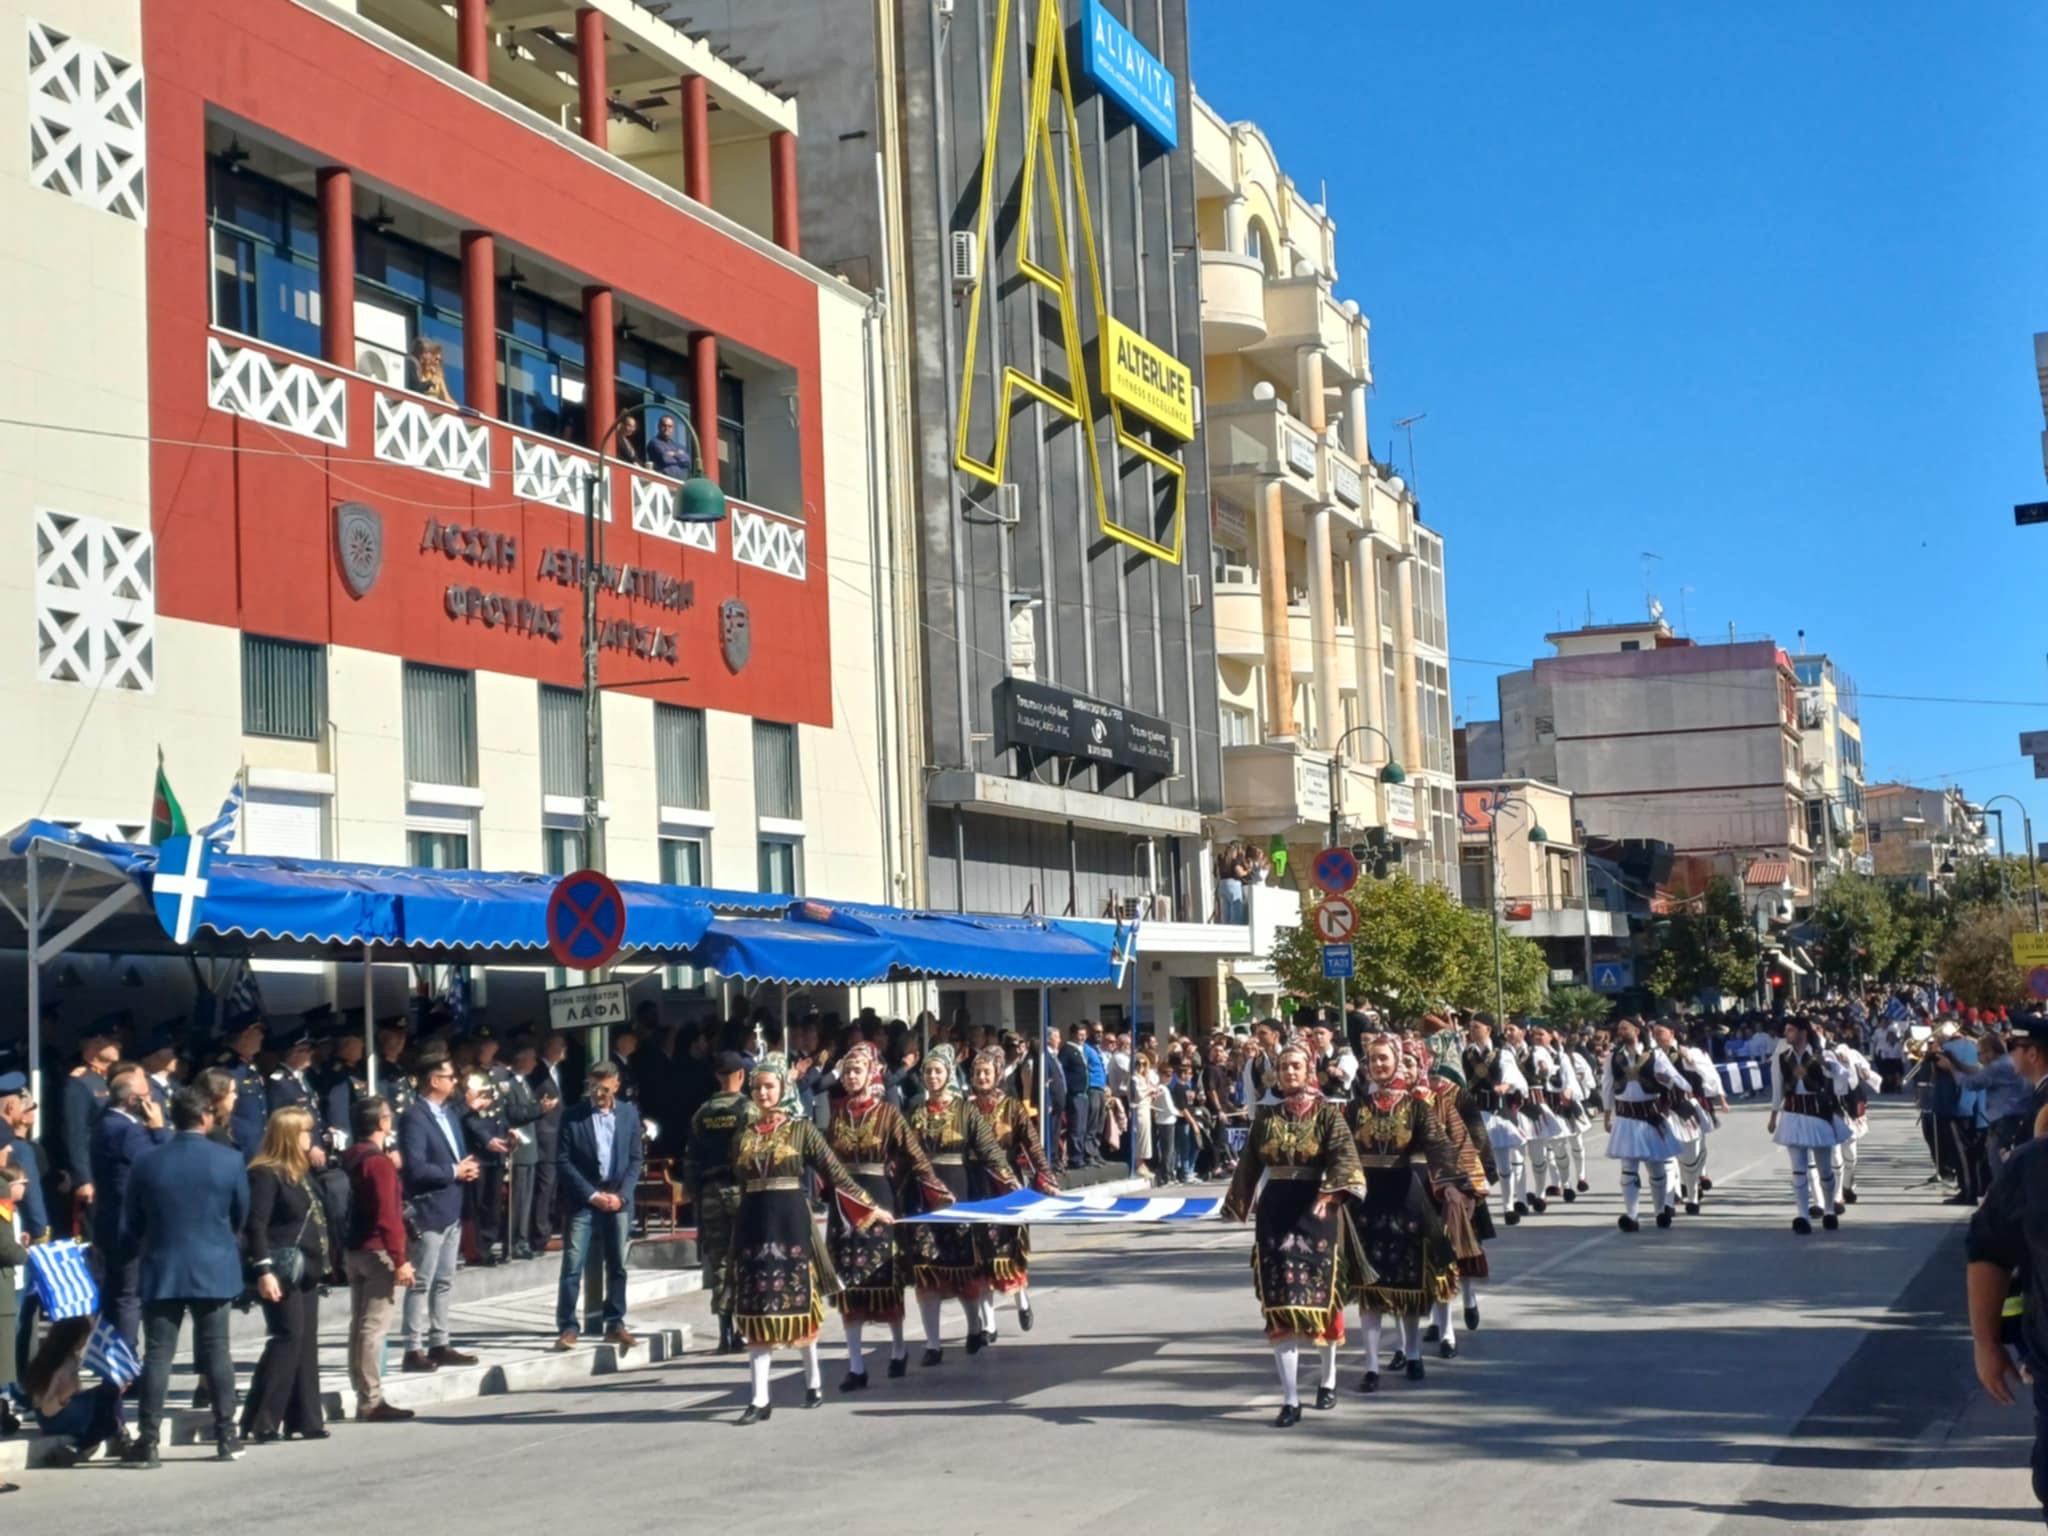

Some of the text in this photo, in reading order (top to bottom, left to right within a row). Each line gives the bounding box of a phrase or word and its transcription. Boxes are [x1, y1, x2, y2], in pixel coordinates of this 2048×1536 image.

[1095, 13, 1174, 113] ALIAVITA
[1117, 336, 1186, 406] ALTERLIFE
[1117, 374, 1188, 425] FITNESS EXCELLENCE
[582, 617, 680, 666] ΑΡΙΣΑΣ
